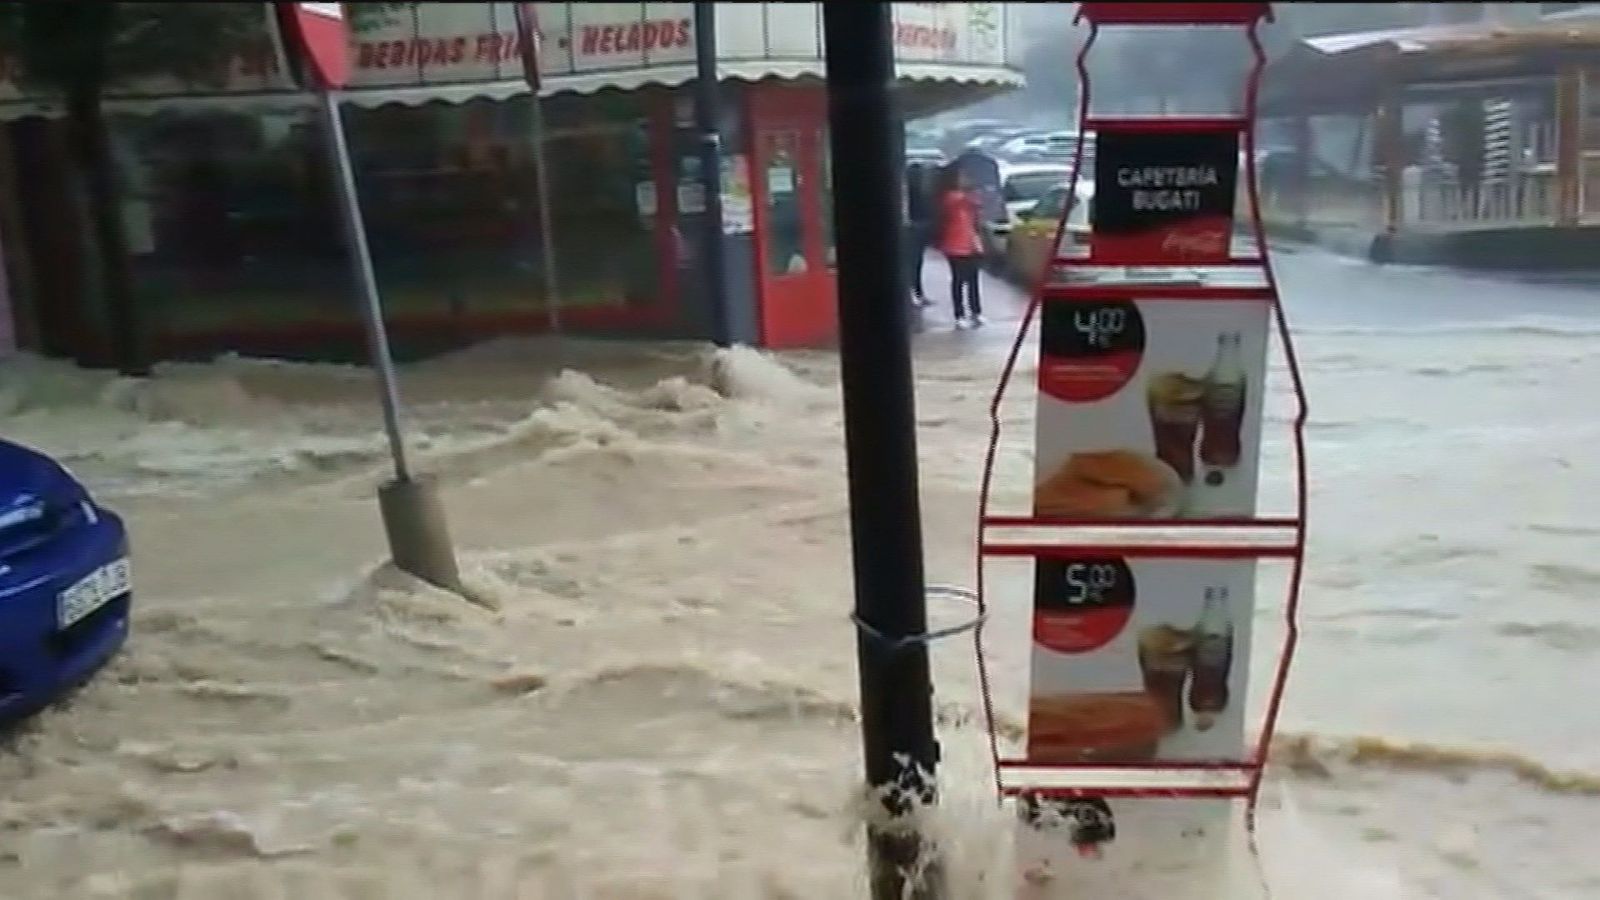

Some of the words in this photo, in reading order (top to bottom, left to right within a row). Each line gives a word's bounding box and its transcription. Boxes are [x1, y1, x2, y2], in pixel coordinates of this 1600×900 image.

[581, 18, 692, 57] HELADOS
[358, 37, 465, 69] BEBIDAS
[1117, 164, 1218, 188] CAFETERÍA
[1132, 189, 1201, 211] BUGATI
